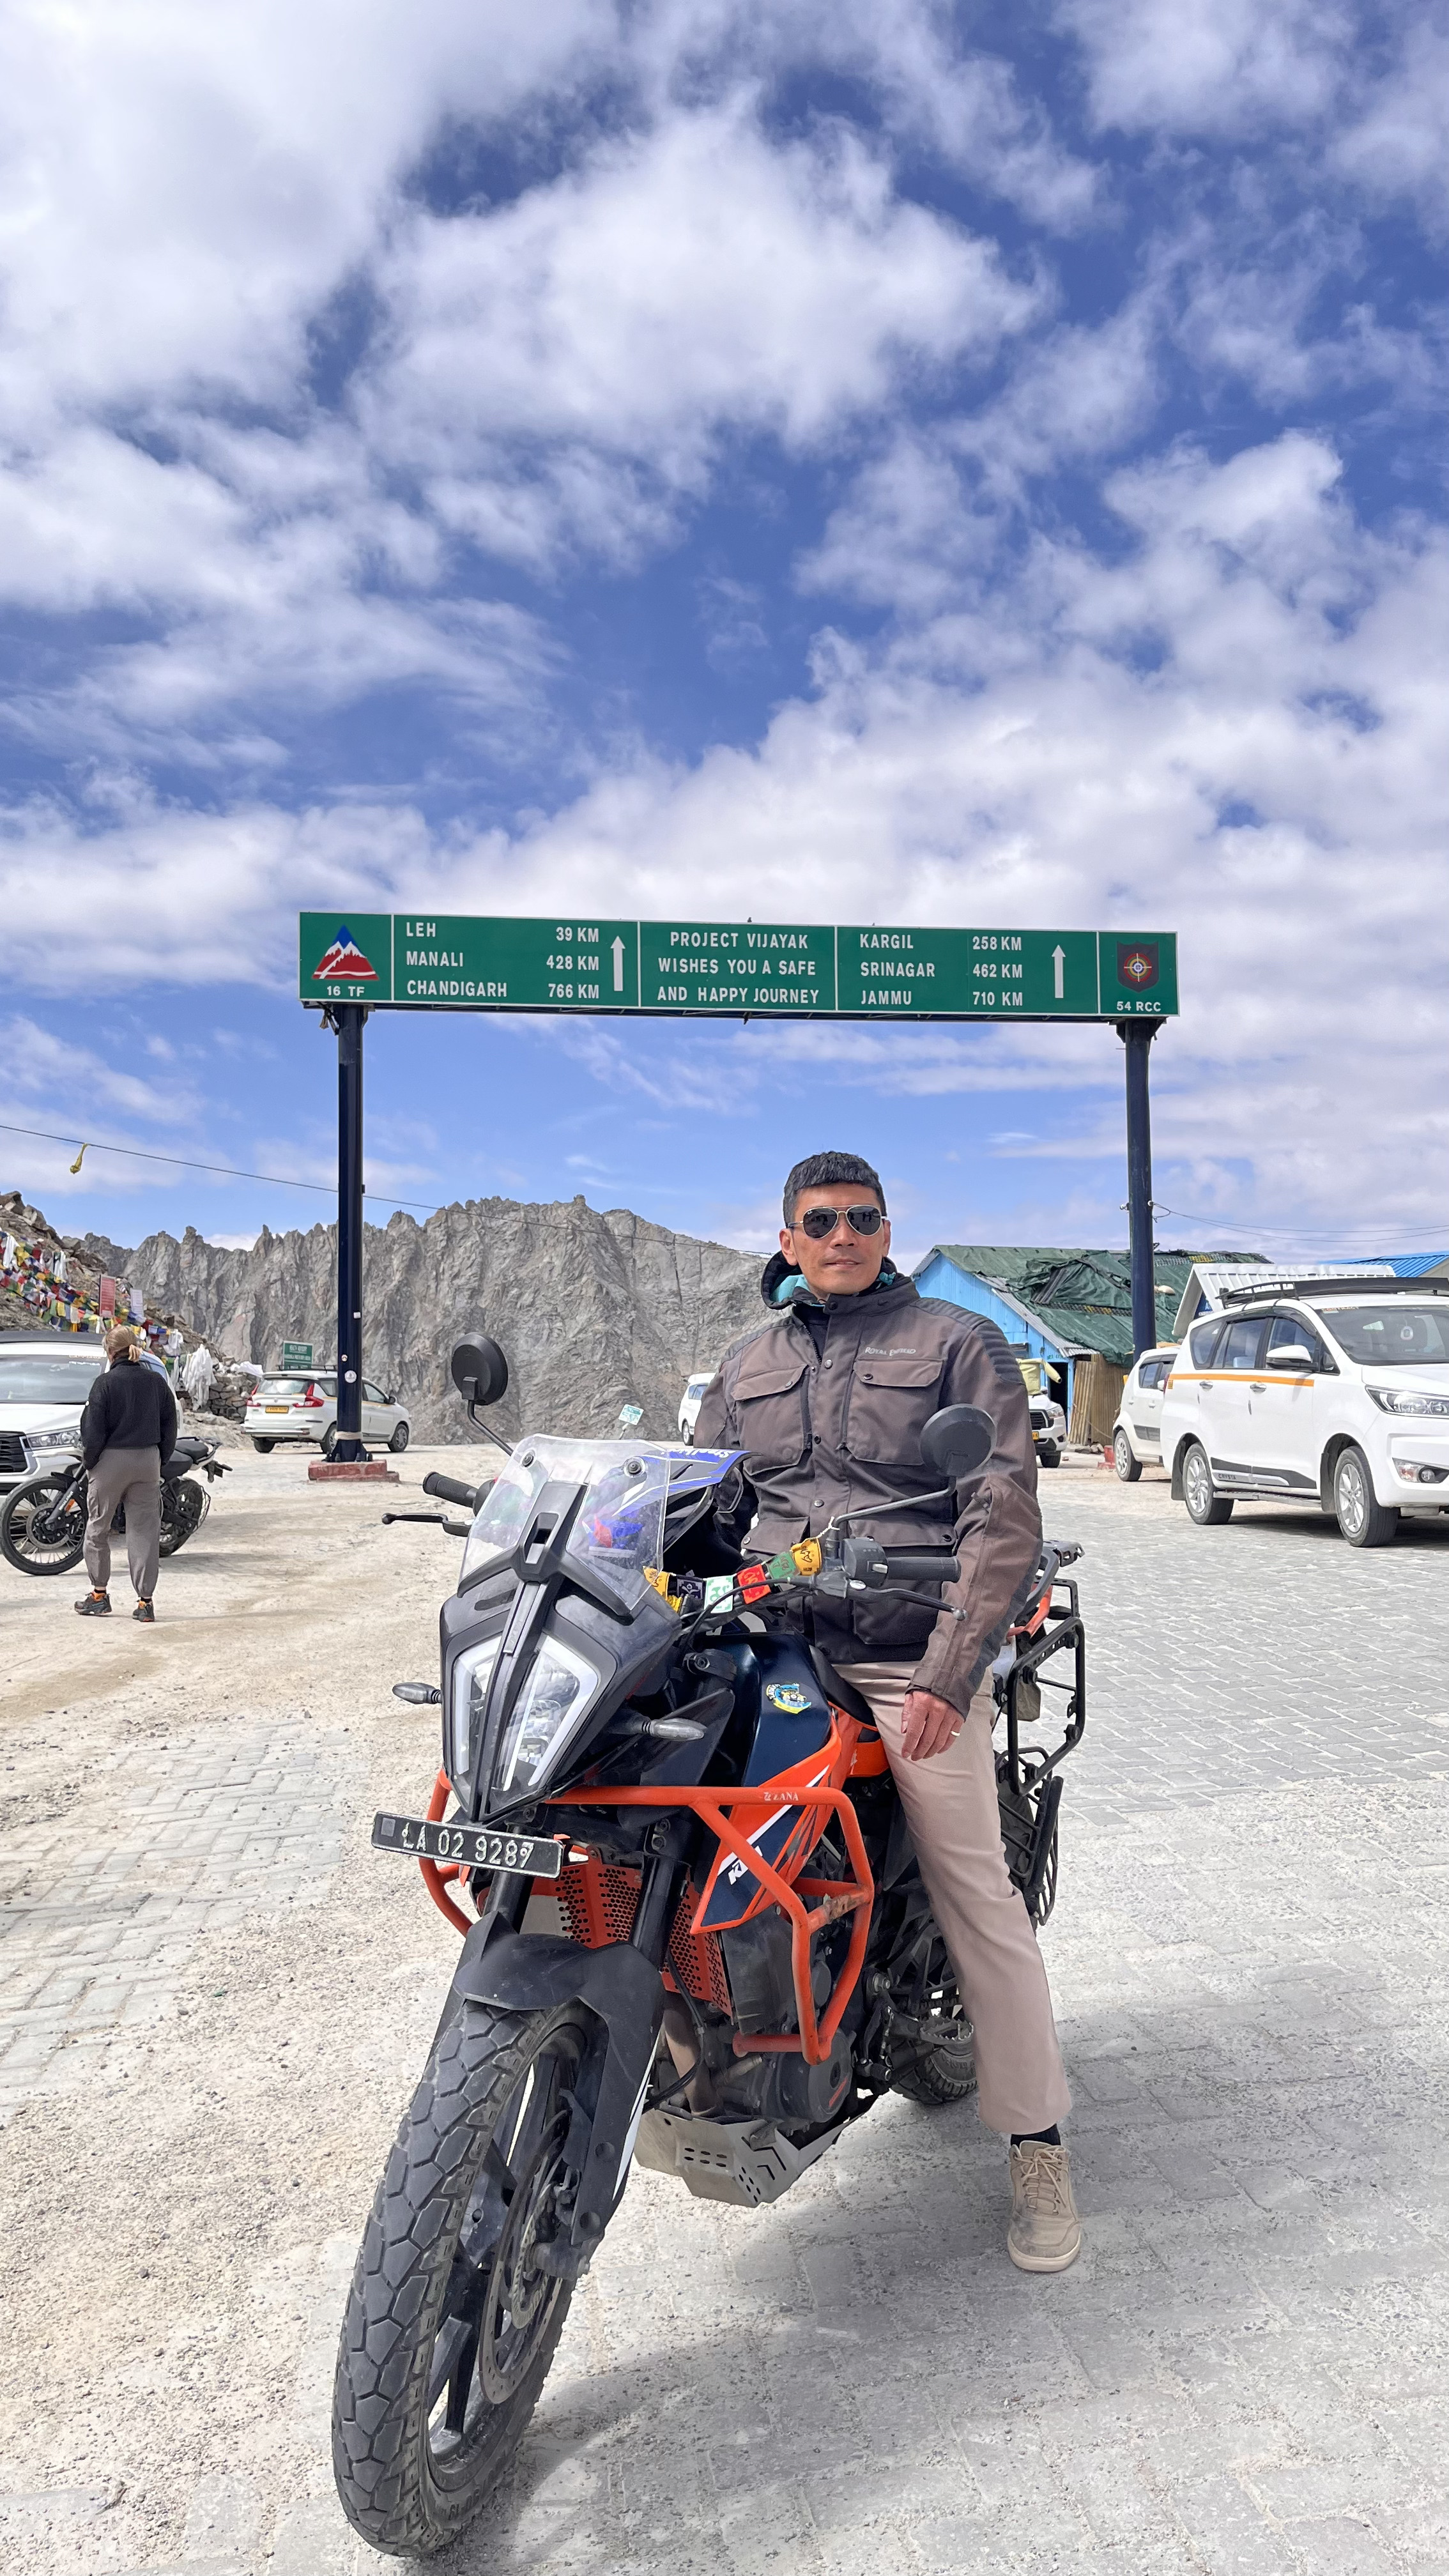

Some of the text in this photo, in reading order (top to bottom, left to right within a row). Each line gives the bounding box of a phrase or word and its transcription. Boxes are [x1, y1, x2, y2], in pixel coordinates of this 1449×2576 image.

[406, 922, 436, 937] LEH
[556, 927, 599, 942] 39 KM
[670, 931, 808, 949] PROJECT VIJAYAK
[860, 934, 914, 949] KARGIL
[972, 937, 1022, 951] 258 KM
[406, 951, 463, 967] MANALI
[546, 955, 599, 970] 428 KM
[658, 958, 816, 976] WISHES YOU A SAFE
[861, 962, 935, 977] SRINAGAR
[972, 963, 1022, 978] 462 KM
[326, 986, 365, 997] 16 TF
[407, 980, 507, 997] CHANDIGARH
[548, 983, 599, 999] 766 KM
[657, 986, 819, 1004] AND HAPPY JOURNEY
[861, 990, 912, 1005] JAMMU
[972, 992, 1023, 1006] 710 KM
[1116, 1001, 1161, 1012] 54 RCC
[865, 1347, 887, 1355] ROYAL
[773, 1791, 799, 1801] ZANA
[401, 1822, 535, 1869] LA 02 9287
[728, 1845, 763, 1885] KT
